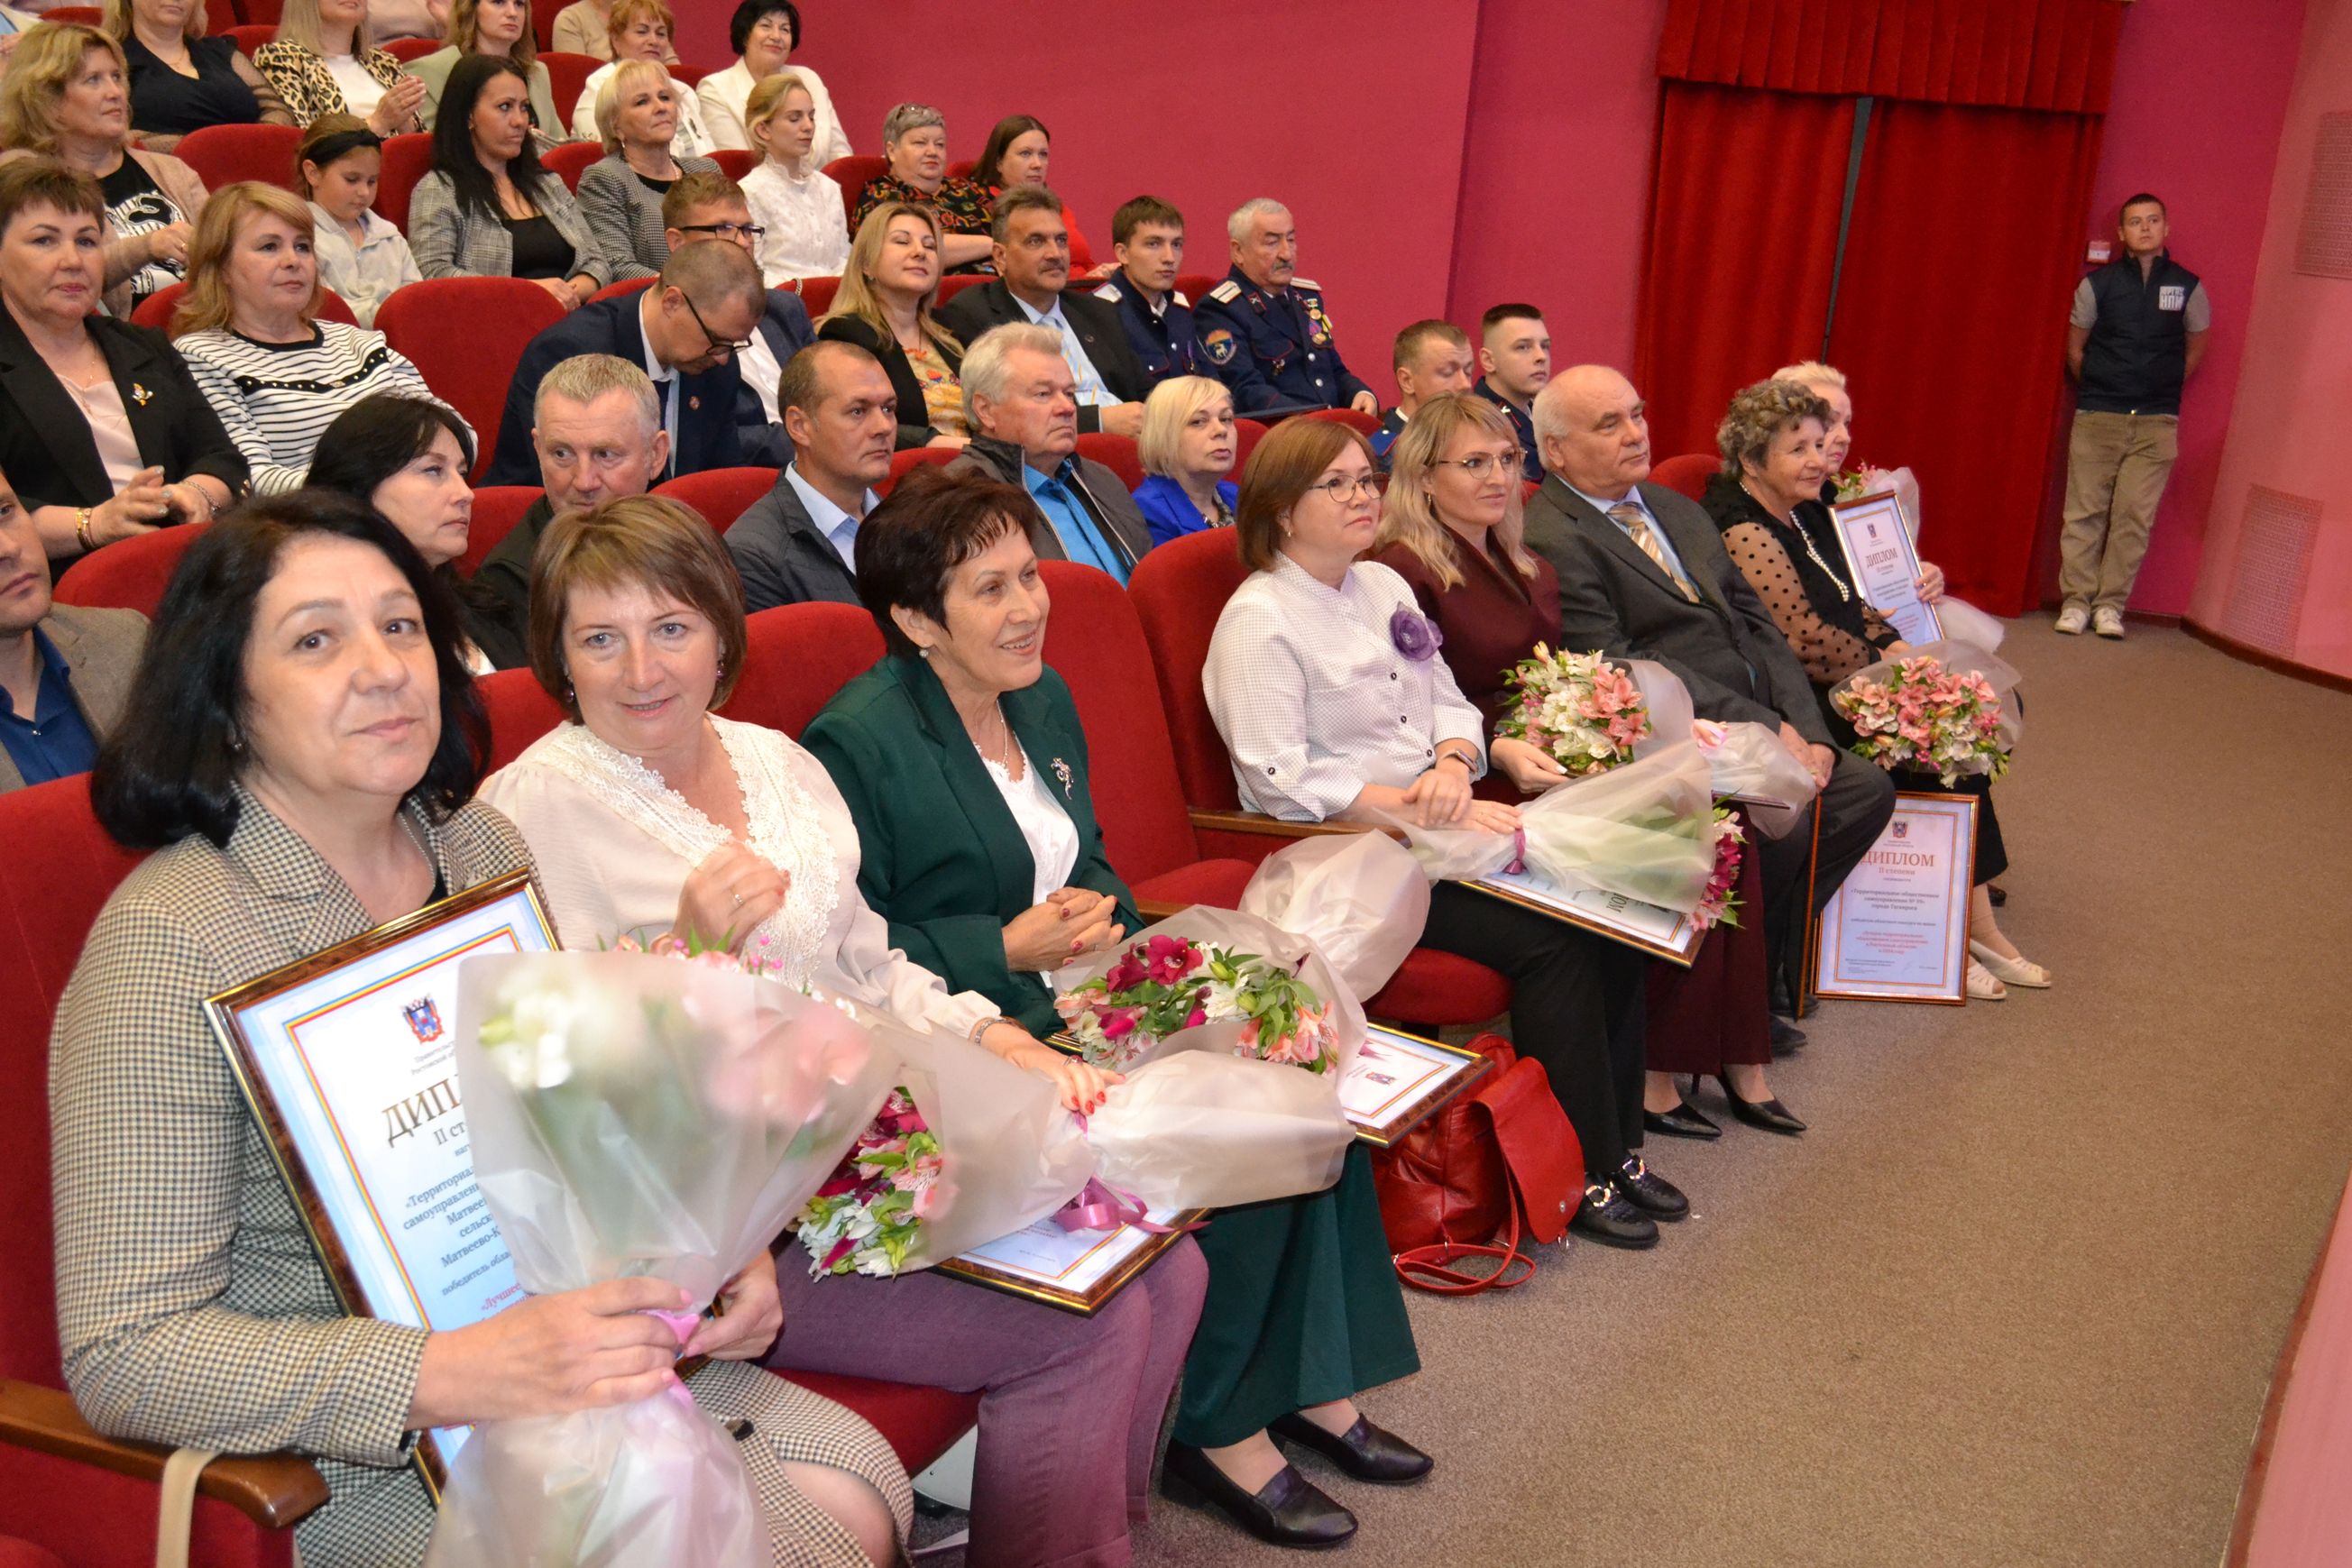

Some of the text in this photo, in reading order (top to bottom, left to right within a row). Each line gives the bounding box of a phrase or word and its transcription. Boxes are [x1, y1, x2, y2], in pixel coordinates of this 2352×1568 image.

[1865, 547, 1898, 569] ДИПЛОМ
[1860, 850, 1934, 867] ДИПЛОМ
[381, 1074, 462, 1149] ДИП
[449, 1122, 467, 1138] ст
